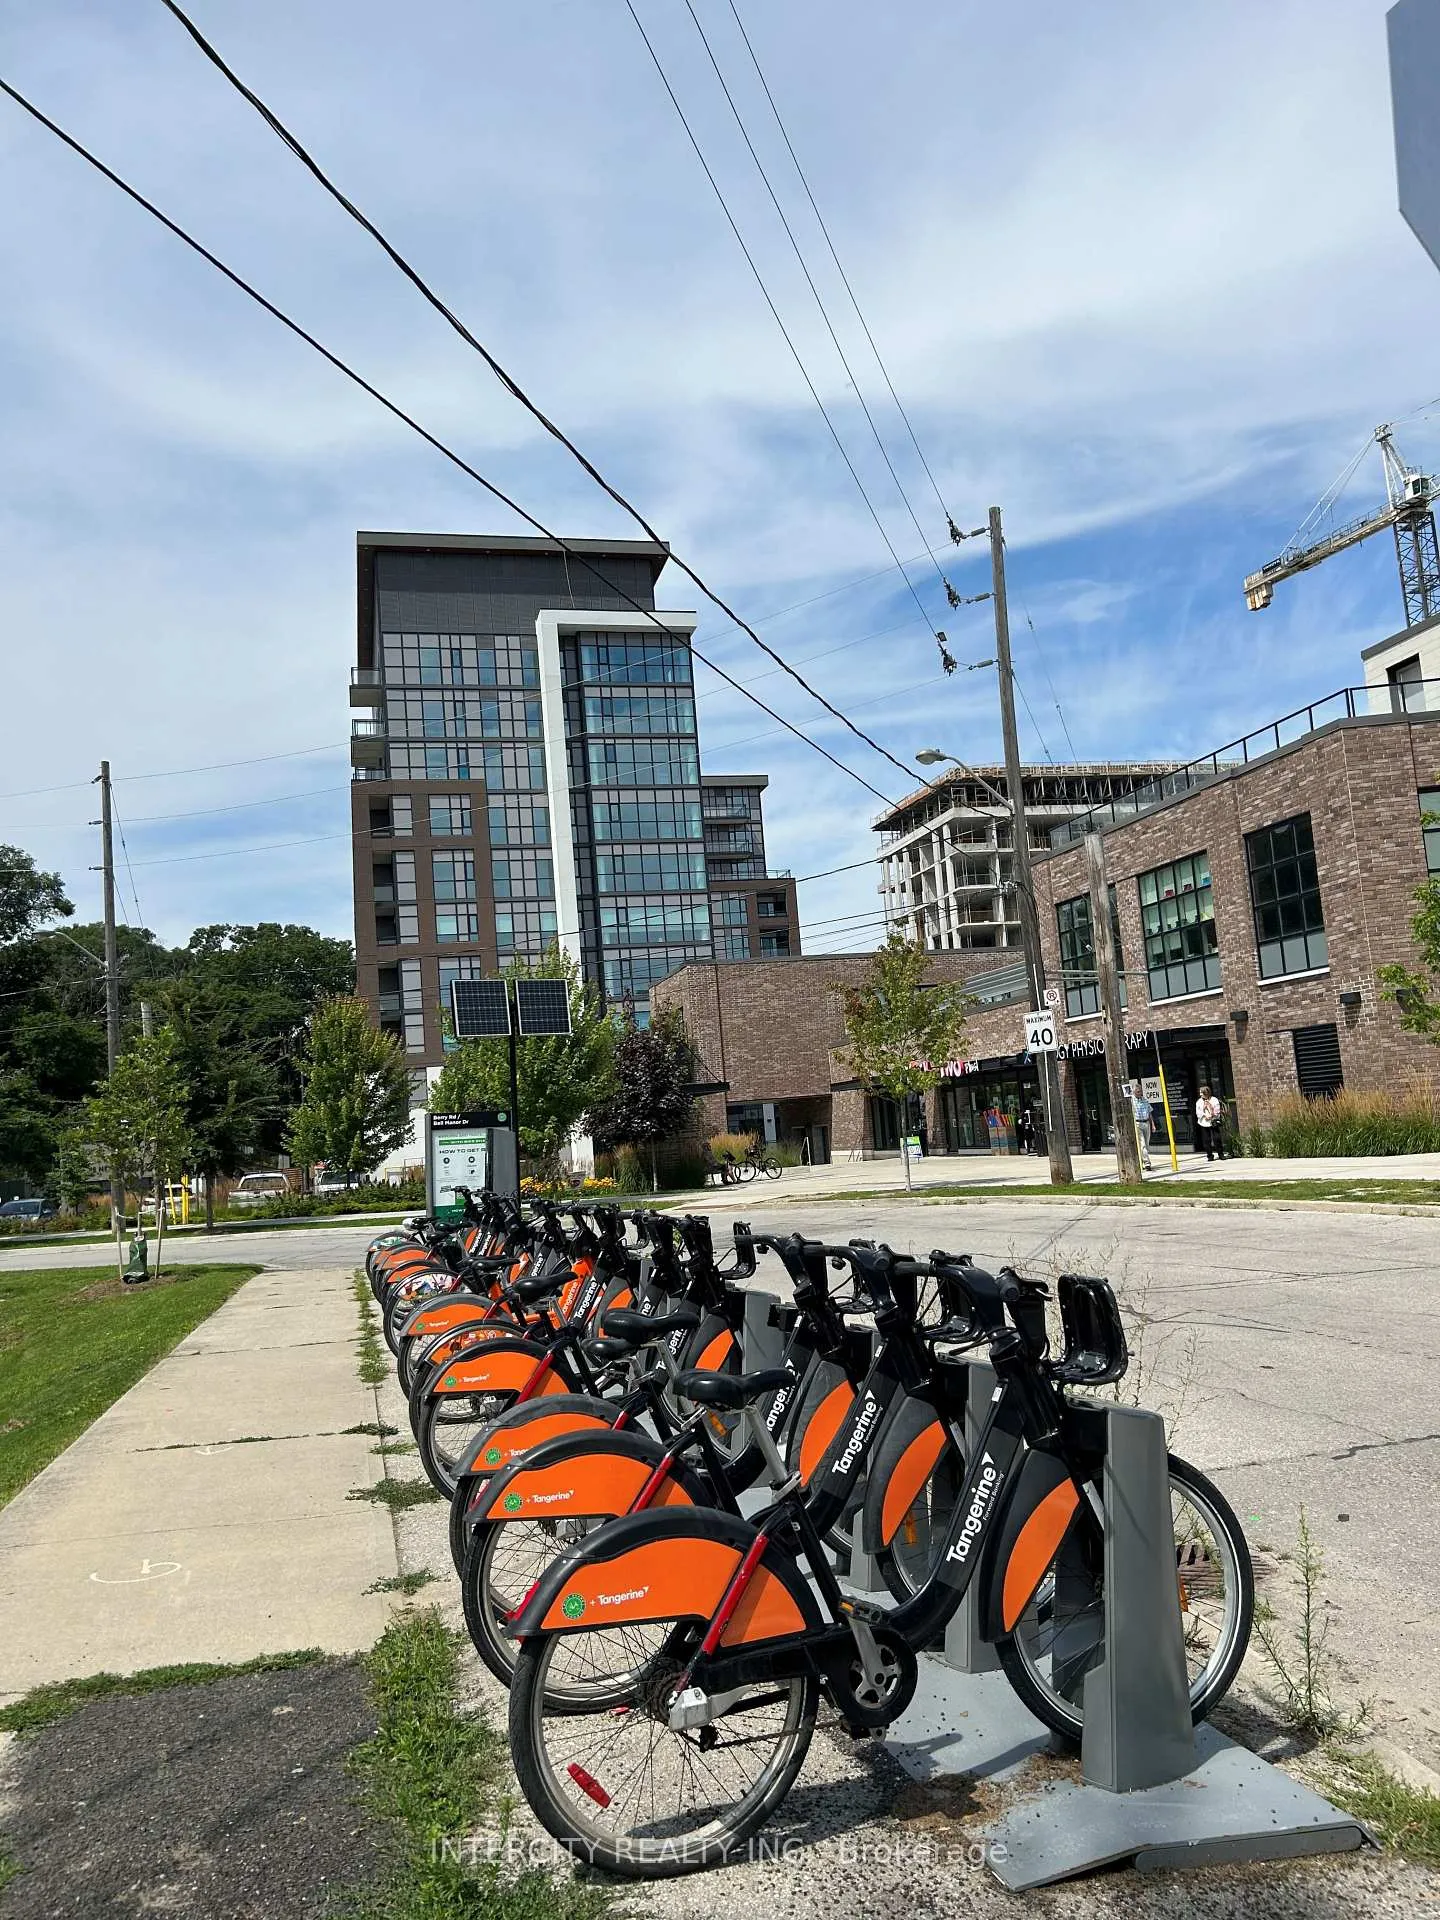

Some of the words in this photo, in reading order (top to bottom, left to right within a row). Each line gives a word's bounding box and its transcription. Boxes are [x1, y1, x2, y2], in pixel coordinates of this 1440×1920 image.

[1026, 1015, 1052, 1024] MAXIMUM
[1030, 1028, 1053, 1046] 40
[1145, 1081, 1158, 1090] NOW
[1146, 1091, 1160, 1099] OPEN
[573, 1281, 597, 1319] Tangerine
[832, 1401, 877, 1474] Tangerine
[532, 1490, 571, 1504] Tangerine
[946, 1467, 997, 1562] Tangerine
[982, 1496, 995, 1521] Forward
[598, 1588, 645, 1606] Tangerine
